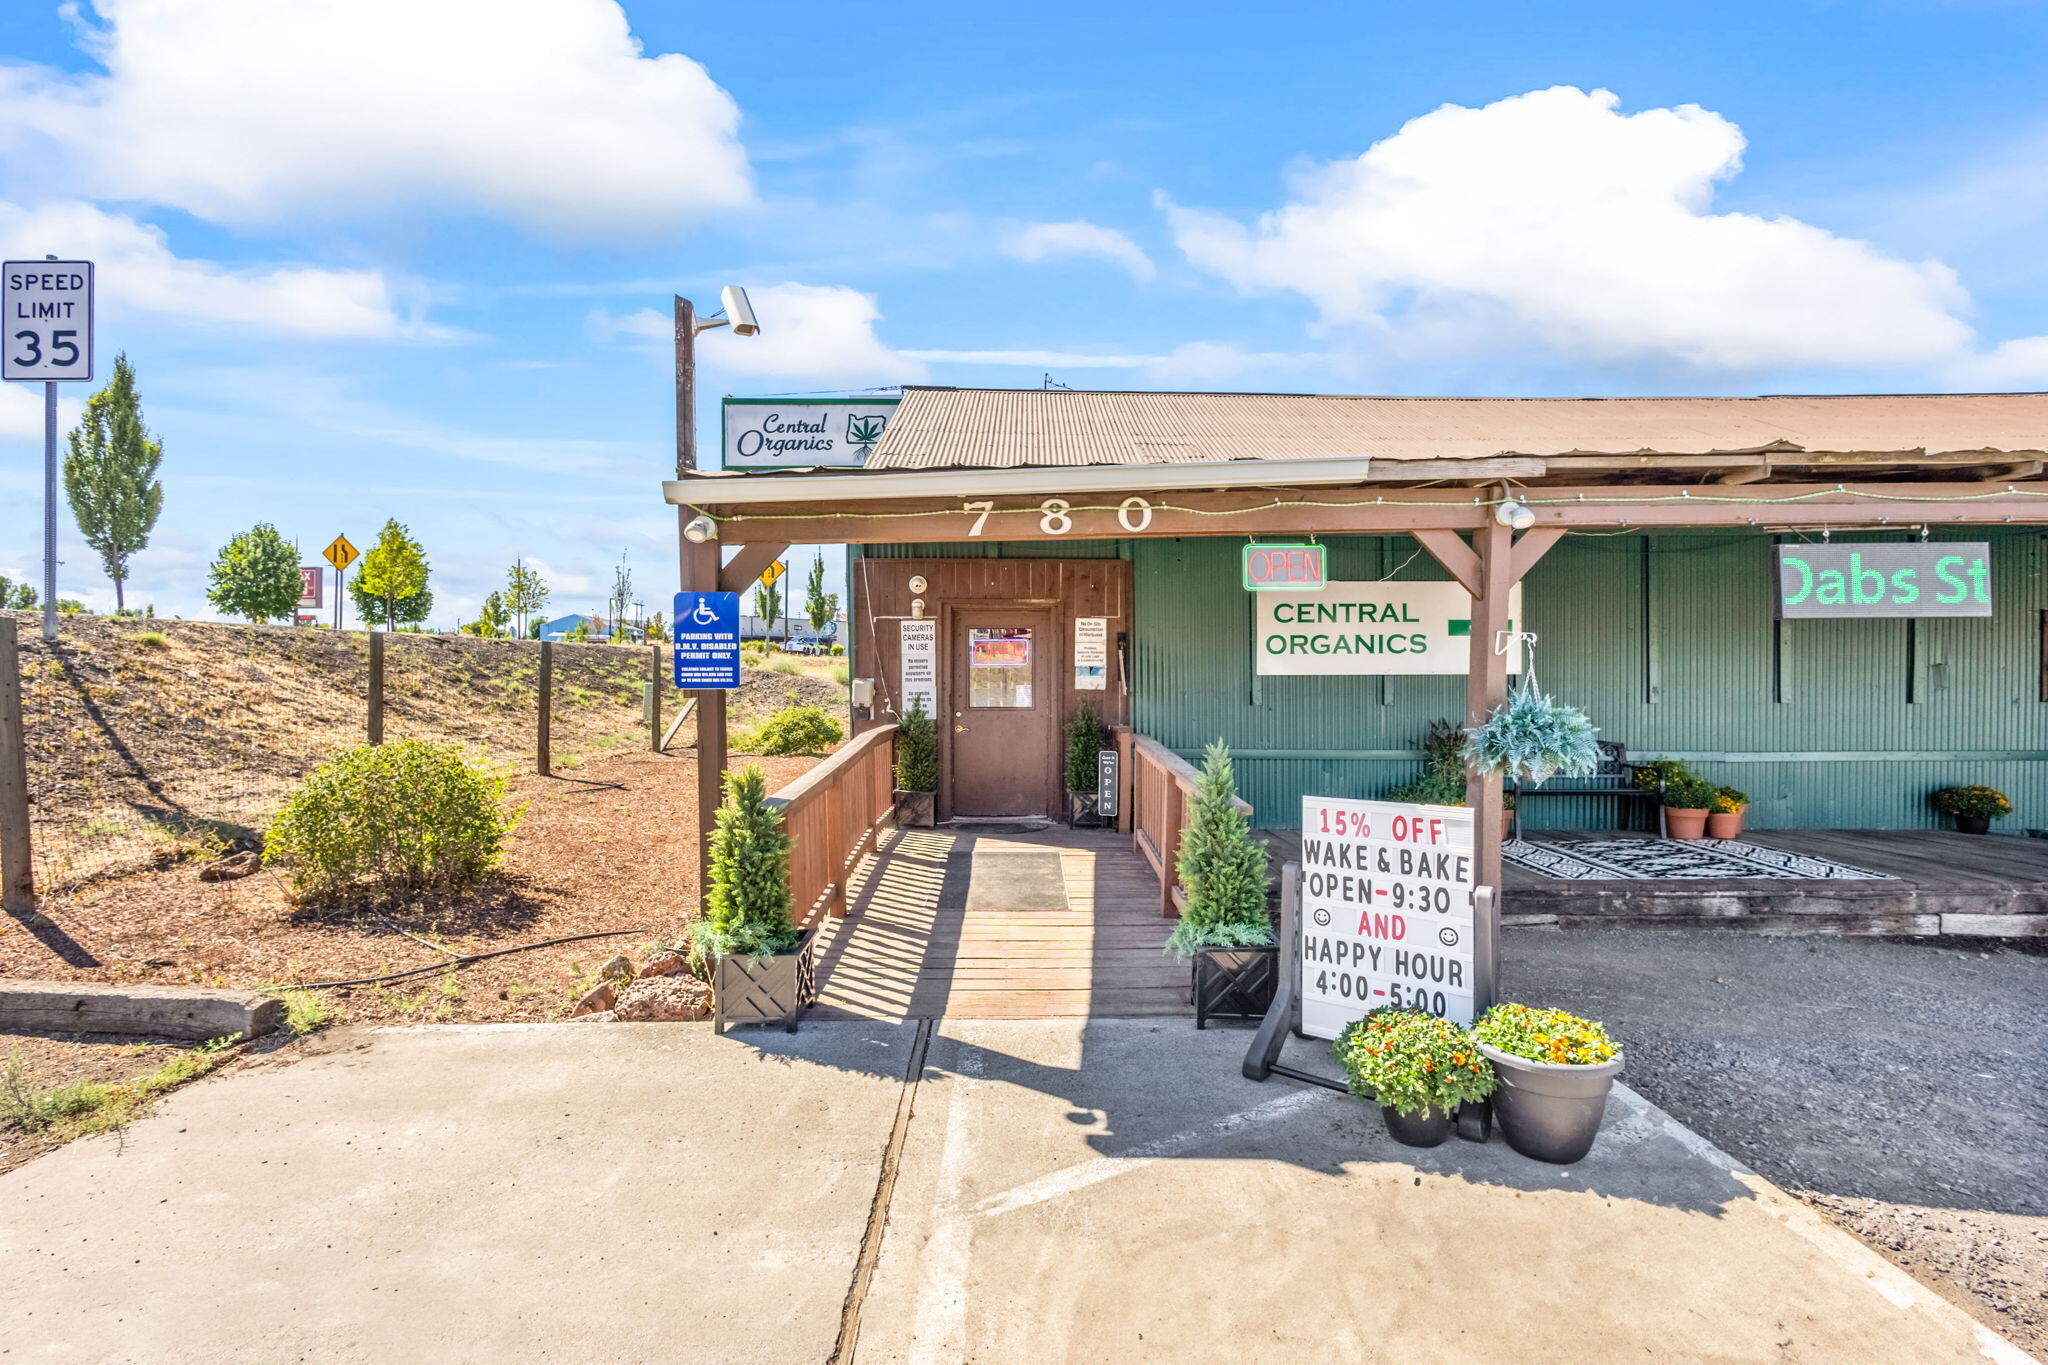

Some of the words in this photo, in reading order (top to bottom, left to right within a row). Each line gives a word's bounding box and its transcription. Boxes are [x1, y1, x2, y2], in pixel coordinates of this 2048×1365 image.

[10, 274, 83, 291] SPEED
[18, 302, 75, 319] LIMIT
[13, 330, 79, 367] 35
[763, 413, 828, 434] Central
[737, 429, 834, 457] Organics
[1249, 551, 1321, 582] OPEN
[1935, 556, 1989, 604] St
[1274, 603, 1420, 624] CENTRAL
[680, 652, 710, 660] PERMIT
[712, 652, 733, 660] ONLY.
[907, 643, 915, 651] IN
[916, 643, 929, 651] USE
[1265, 633, 1428, 655] ORGANICS
[1104, 766, 1112, 810] OPEN
[1320, 808, 1371, 839] 15%
[1392, 815, 1442, 845] OFF
[1304, 839, 1369, 871] WAKE
[1377, 847, 1391, 873] &
[1400, 848, 1470, 883] BAKE
[1358, 911, 1406, 941] AND
[1304, 935, 1382, 972] HAPPY
[1395, 949, 1463, 988] HOUR
